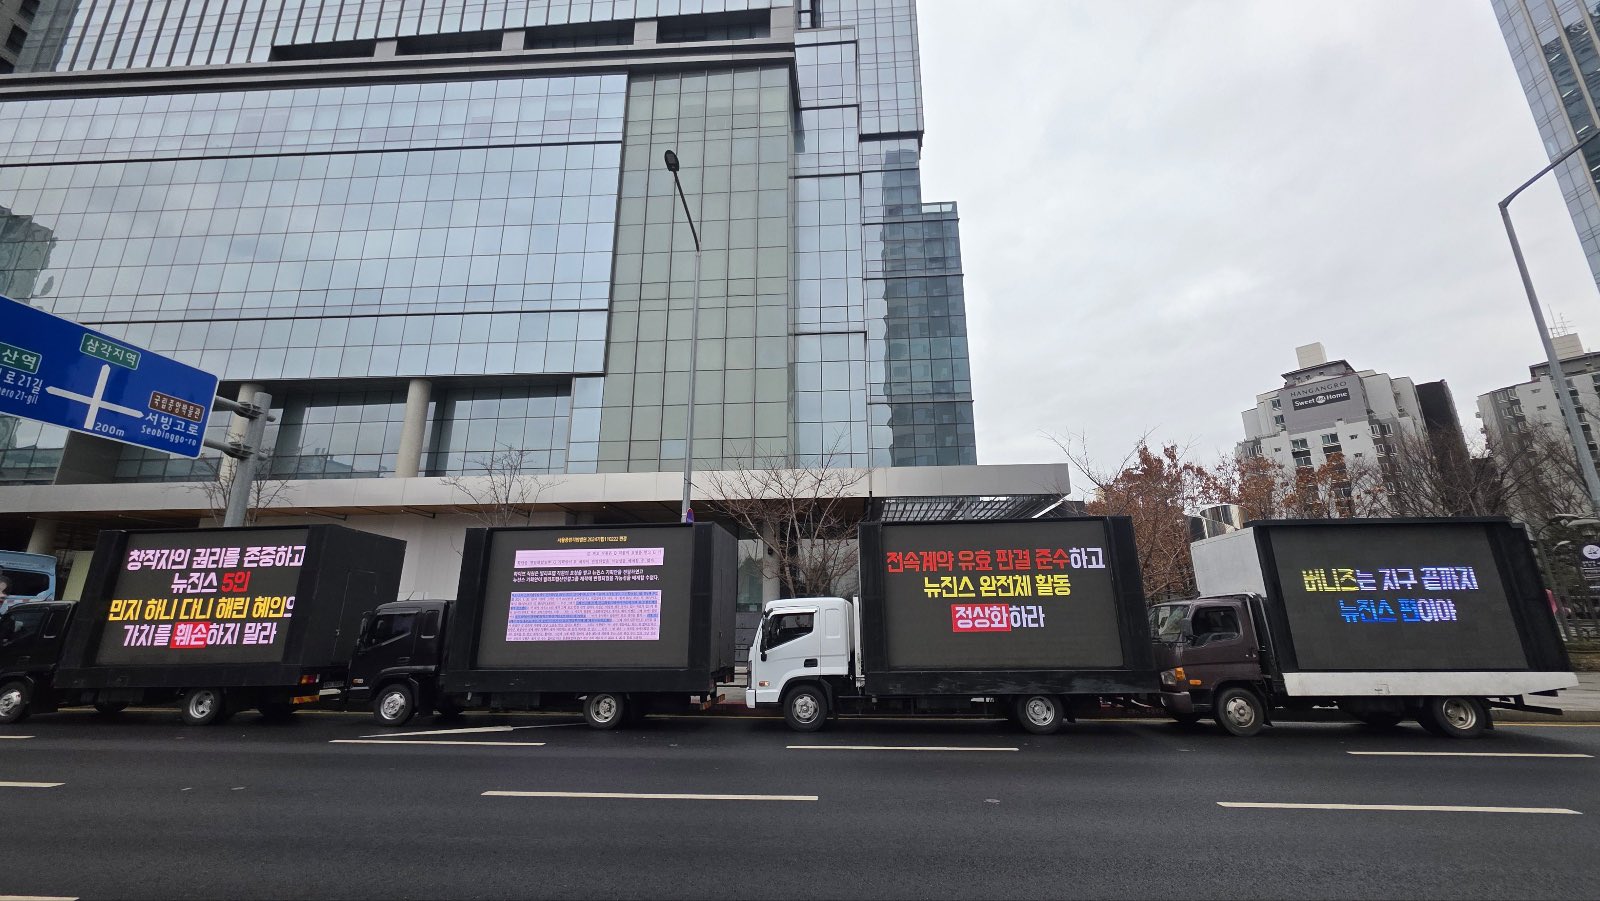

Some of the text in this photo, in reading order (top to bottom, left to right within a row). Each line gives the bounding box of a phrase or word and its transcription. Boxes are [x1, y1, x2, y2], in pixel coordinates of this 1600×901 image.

[1, 349, 37, 370] 산역
[87, 338, 137, 366] 삼각지역
[15, 390, 39, 405] 21-gil
[1290, 381, 1347, 397] HANGANGRO
[1294, 398, 1315, 407] Sweet
[1326, 392, 1348, 400] Home
[154, 394, 201, 419] 국립중앙박물관
[94, 422, 125, 437] 200m
[140, 424, 197, 446] Seobinggo-ro
[145, 412, 199, 436] 서빙고로
[127, 545, 307, 571] 창작자의 권리를 존중하고
[886, 547, 1105, 573] 전속계약 유효 판결 준수하고
[171, 571, 251, 594] 뉴진스 5인
[923, 574, 1071, 599] 뉴진스 완전체 활동
[1302, 566, 1479, 592] 버니즈는 지구 끝까지
[108, 599, 142, 621] 민지
[144, 598, 178, 621] 하니
[179, 598, 213, 620] 다니
[215, 596, 250, 619] 해린
[955, 605, 1046, 629] 정상화하라
[1339, 599, 1457, 623] 뉴진스 편이야
[123, 622, 277, 647] 가치를 훼손하지 말라
